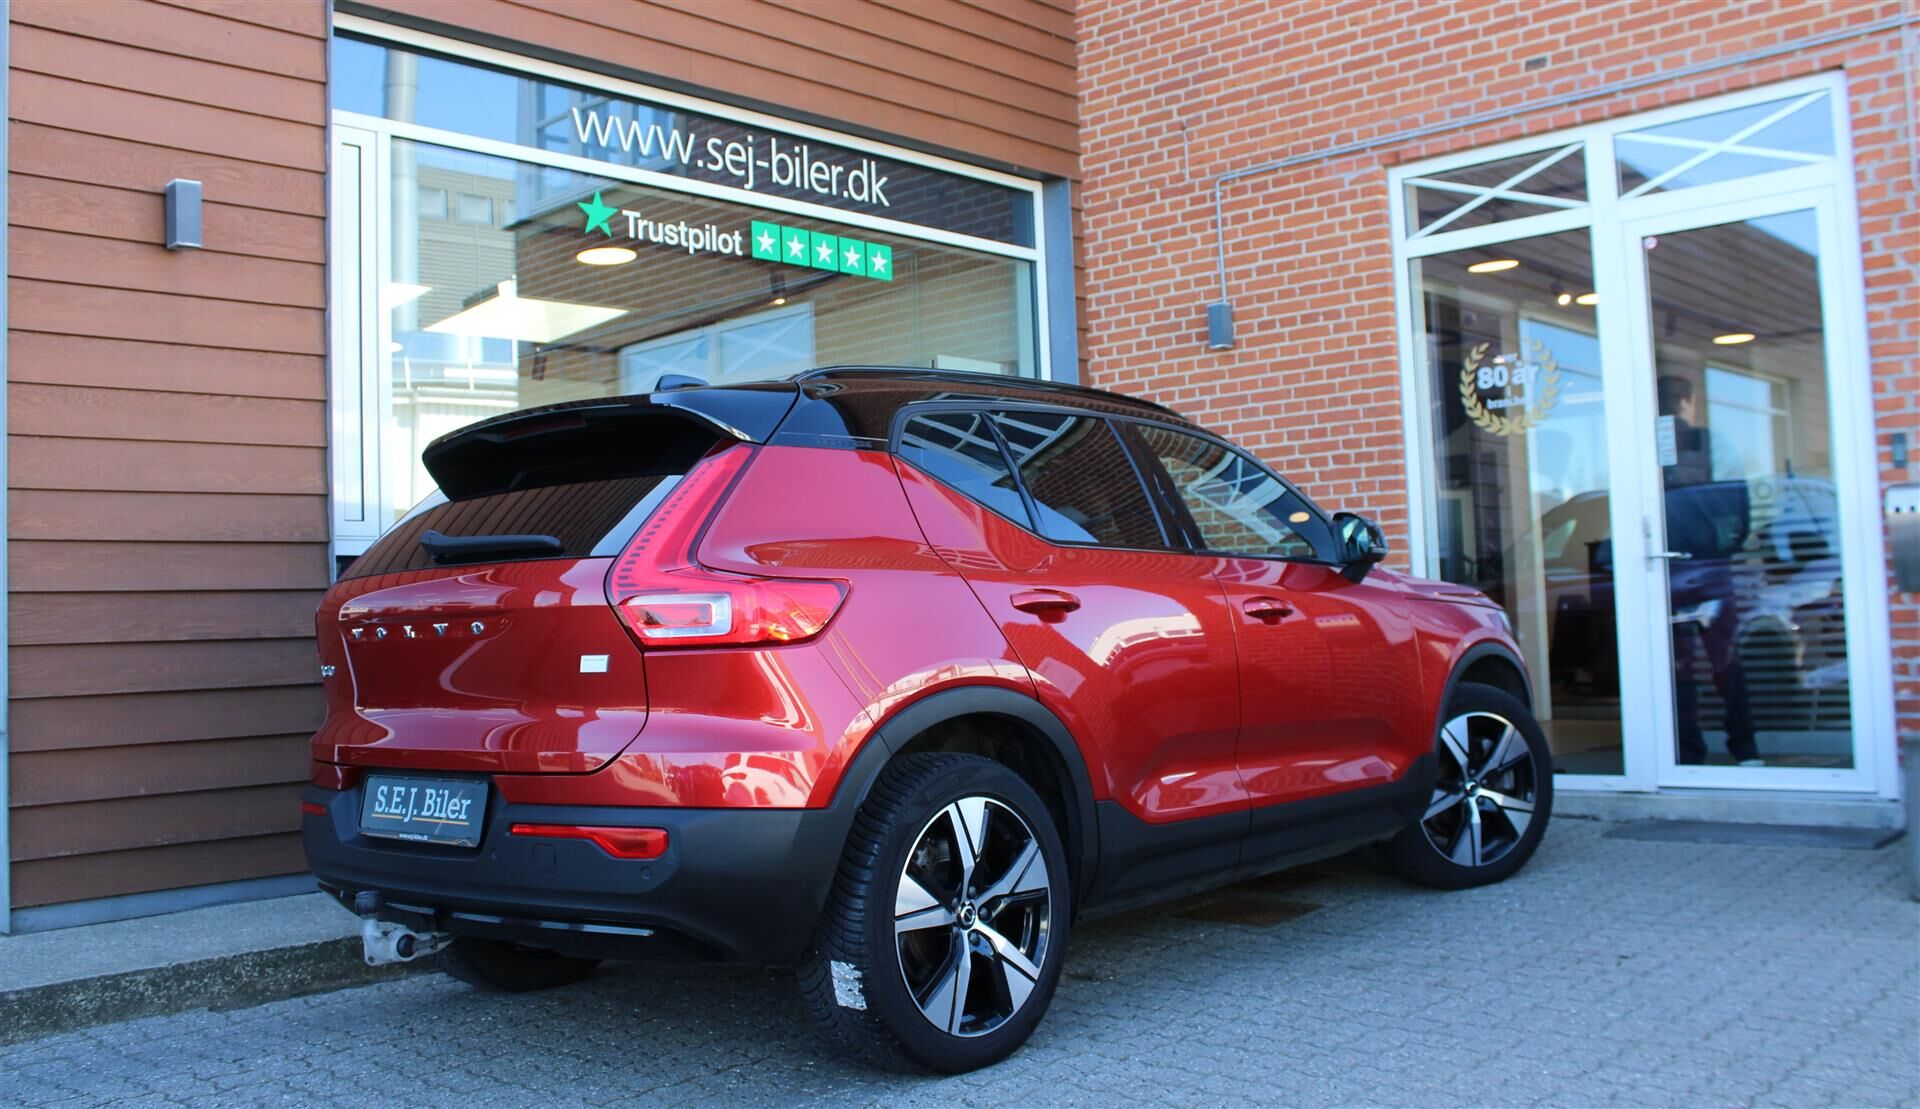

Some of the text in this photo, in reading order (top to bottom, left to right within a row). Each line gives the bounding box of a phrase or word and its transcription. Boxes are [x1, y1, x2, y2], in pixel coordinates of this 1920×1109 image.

[572, 106, 890, 207] www.sej-biler.dk
[622, 210, 743, 256] Trustpilot
[1477, 360, 1539, 390] 80 år
[351, 621, 485, 639] VOLVO
[374, 785, 471, 822] S.E.J. Biler
